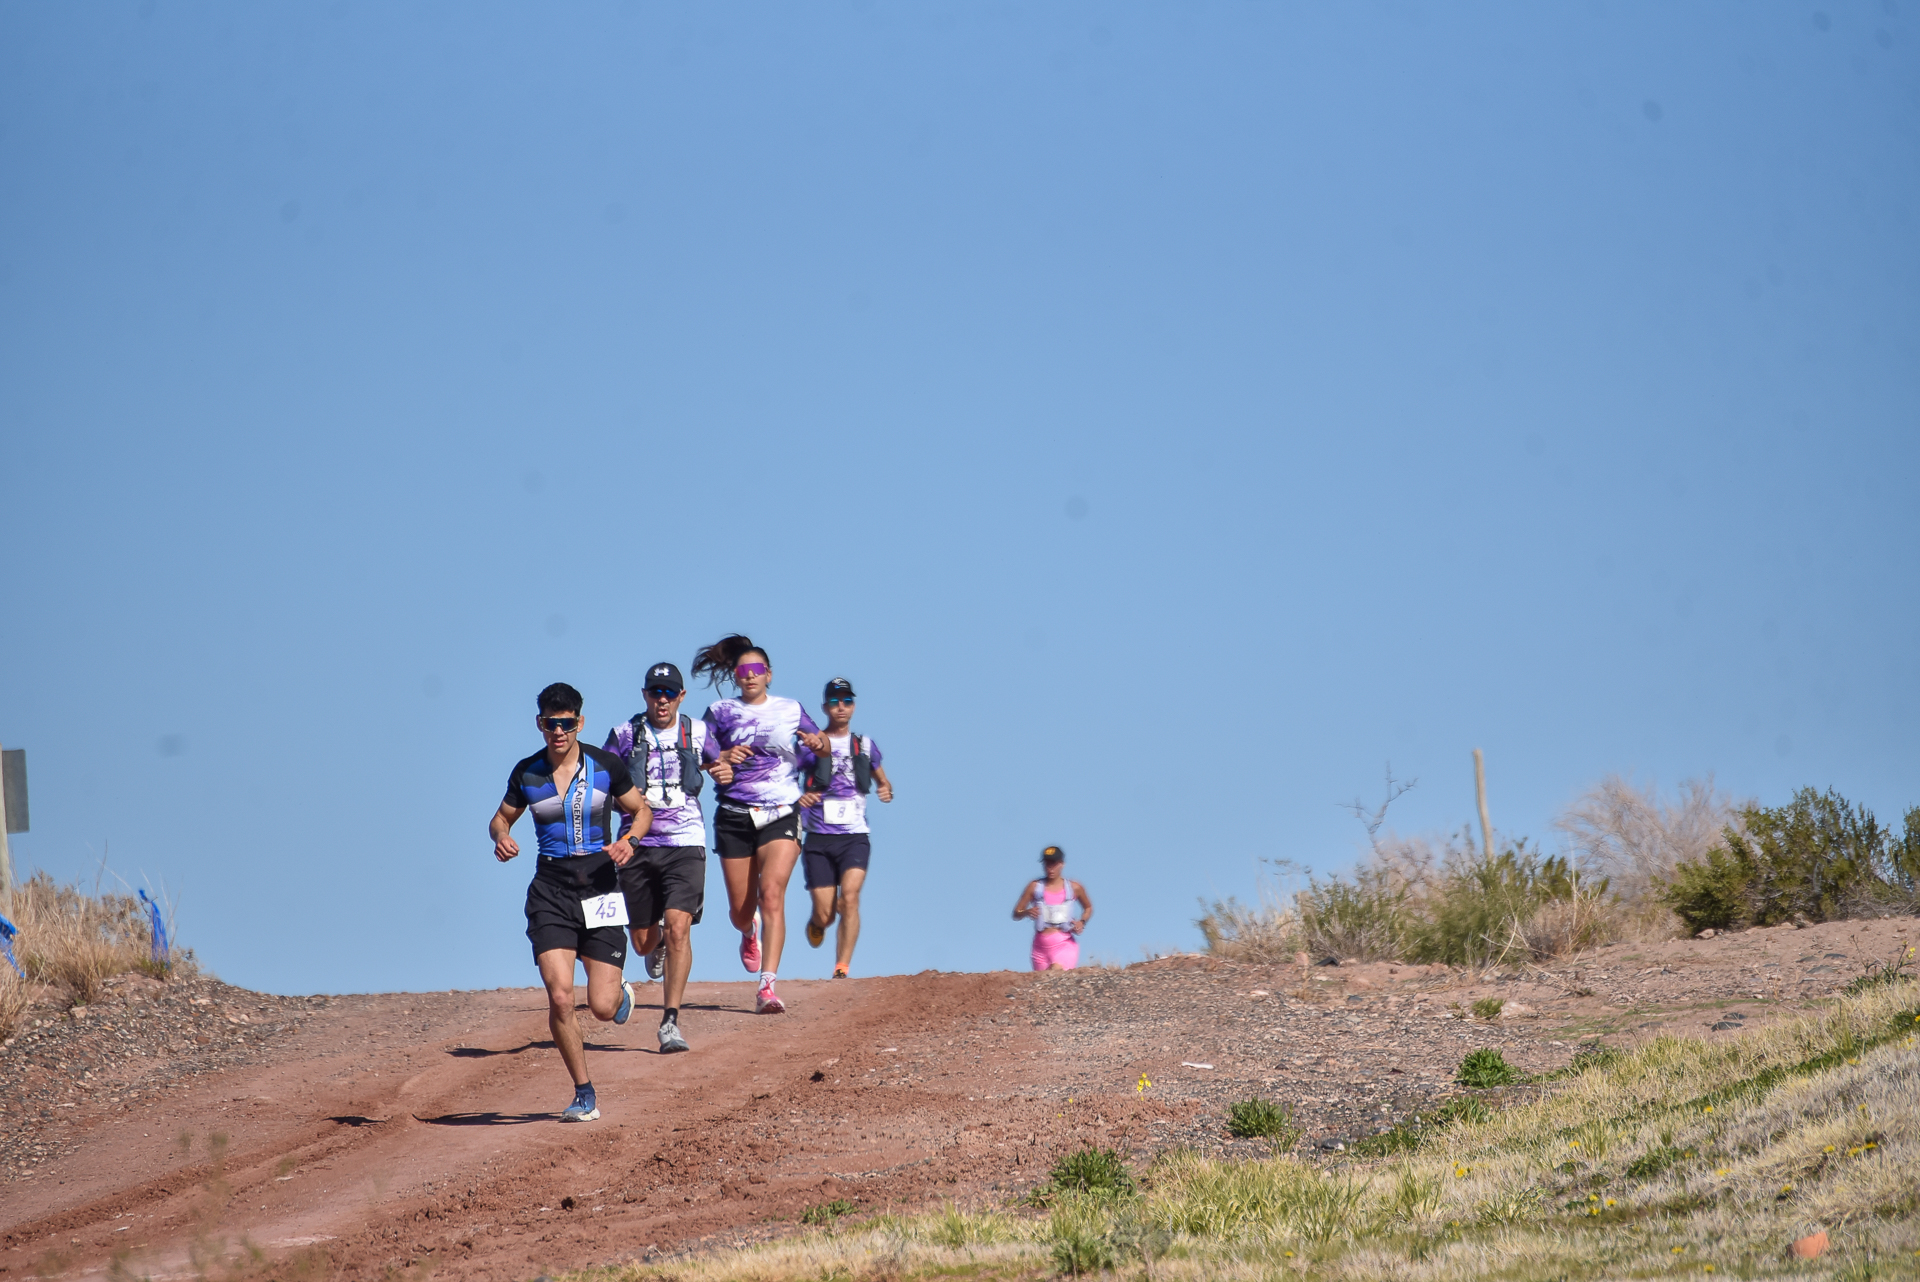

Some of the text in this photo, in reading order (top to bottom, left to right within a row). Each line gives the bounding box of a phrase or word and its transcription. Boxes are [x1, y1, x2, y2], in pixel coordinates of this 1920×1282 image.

[574, 790, 584, 844] ARGENTINA
[838, 806, 846, 818] 8
[595, 901, 616, 920] 45
